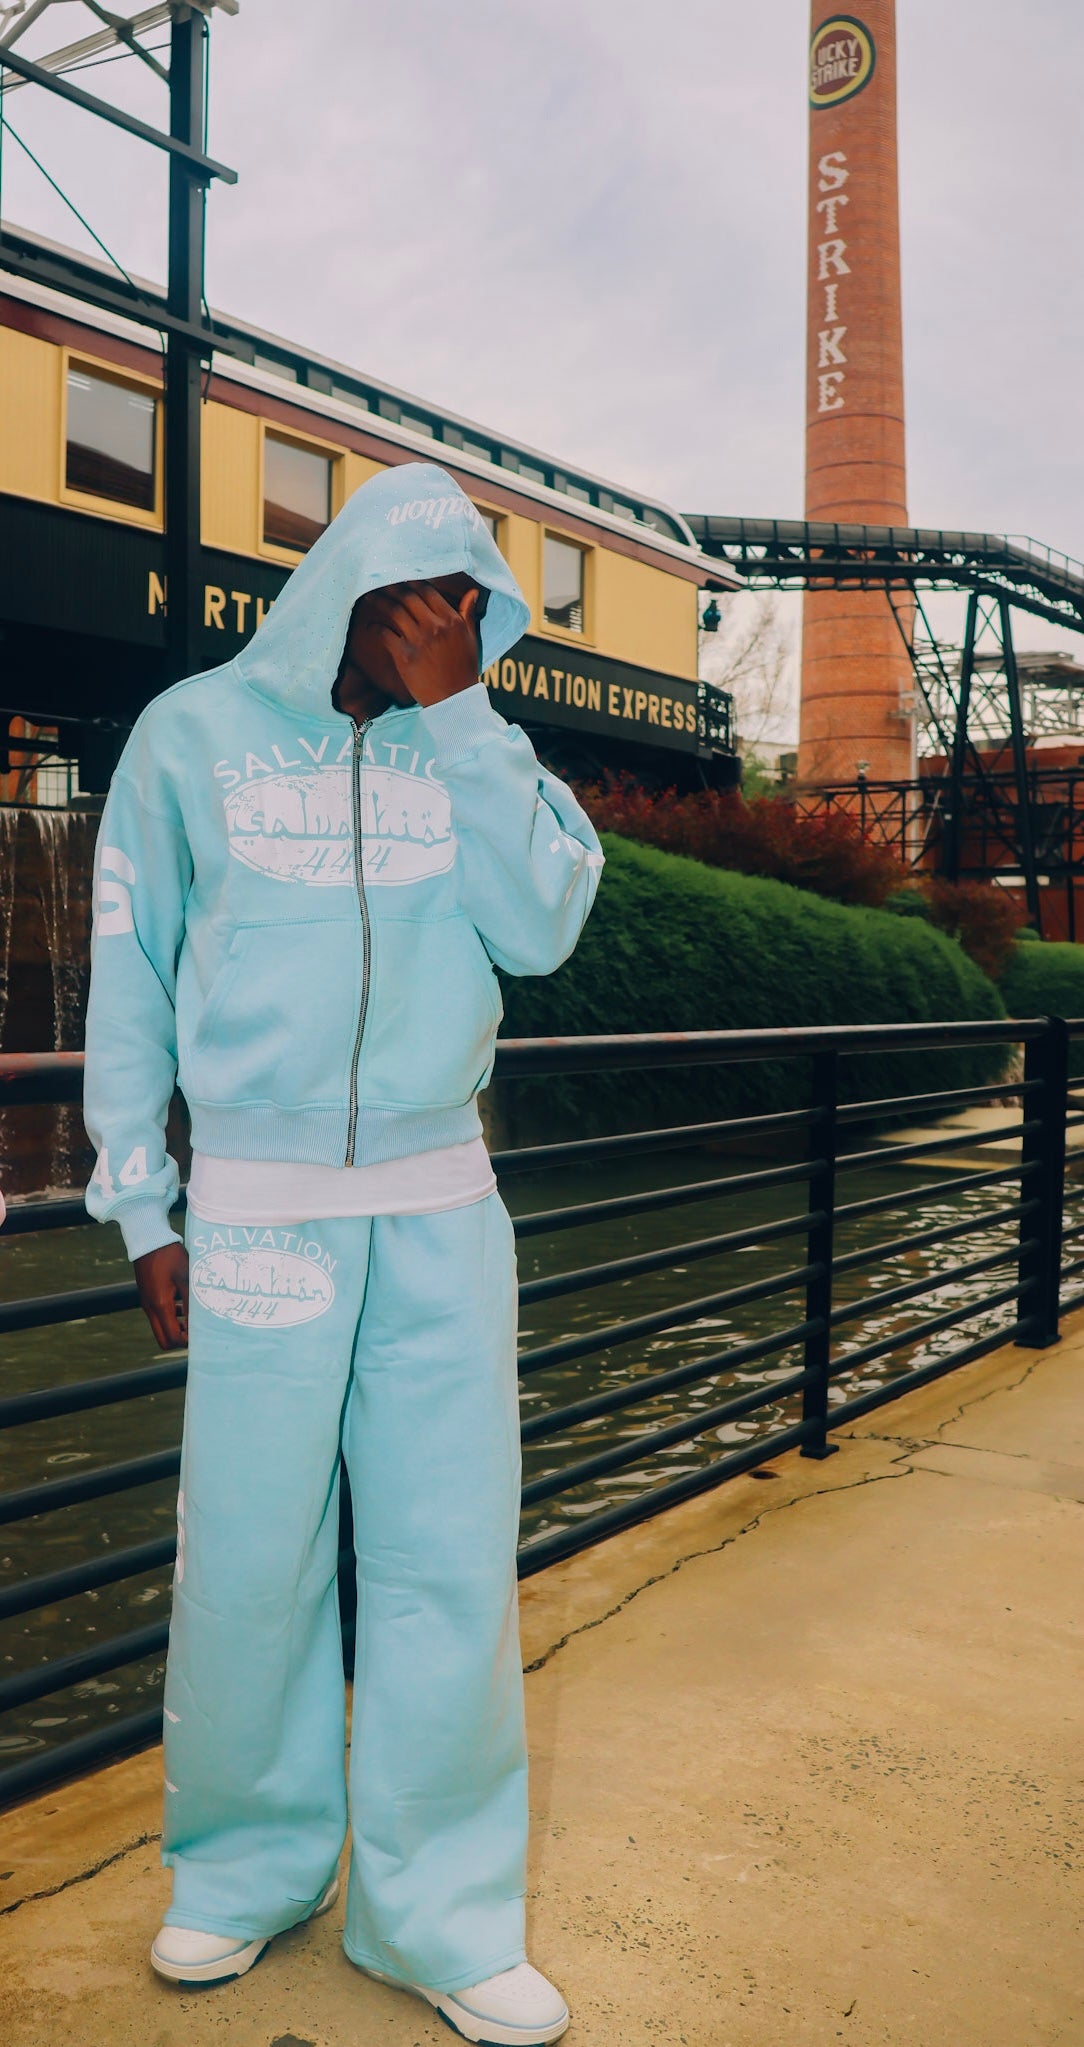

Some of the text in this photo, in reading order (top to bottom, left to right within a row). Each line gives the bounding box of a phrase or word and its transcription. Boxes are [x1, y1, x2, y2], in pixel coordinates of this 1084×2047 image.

[813, 38, 859, 67] UCKY
[816, 151, 852, 413] STRIKE
[147, 571, 276, 634] NRT
[478, 657, 698, 734] NOVATION EXPRESS
[193, 1227, 338, 1274] SALVATION
[231, 1297, 279, 1321] 444
